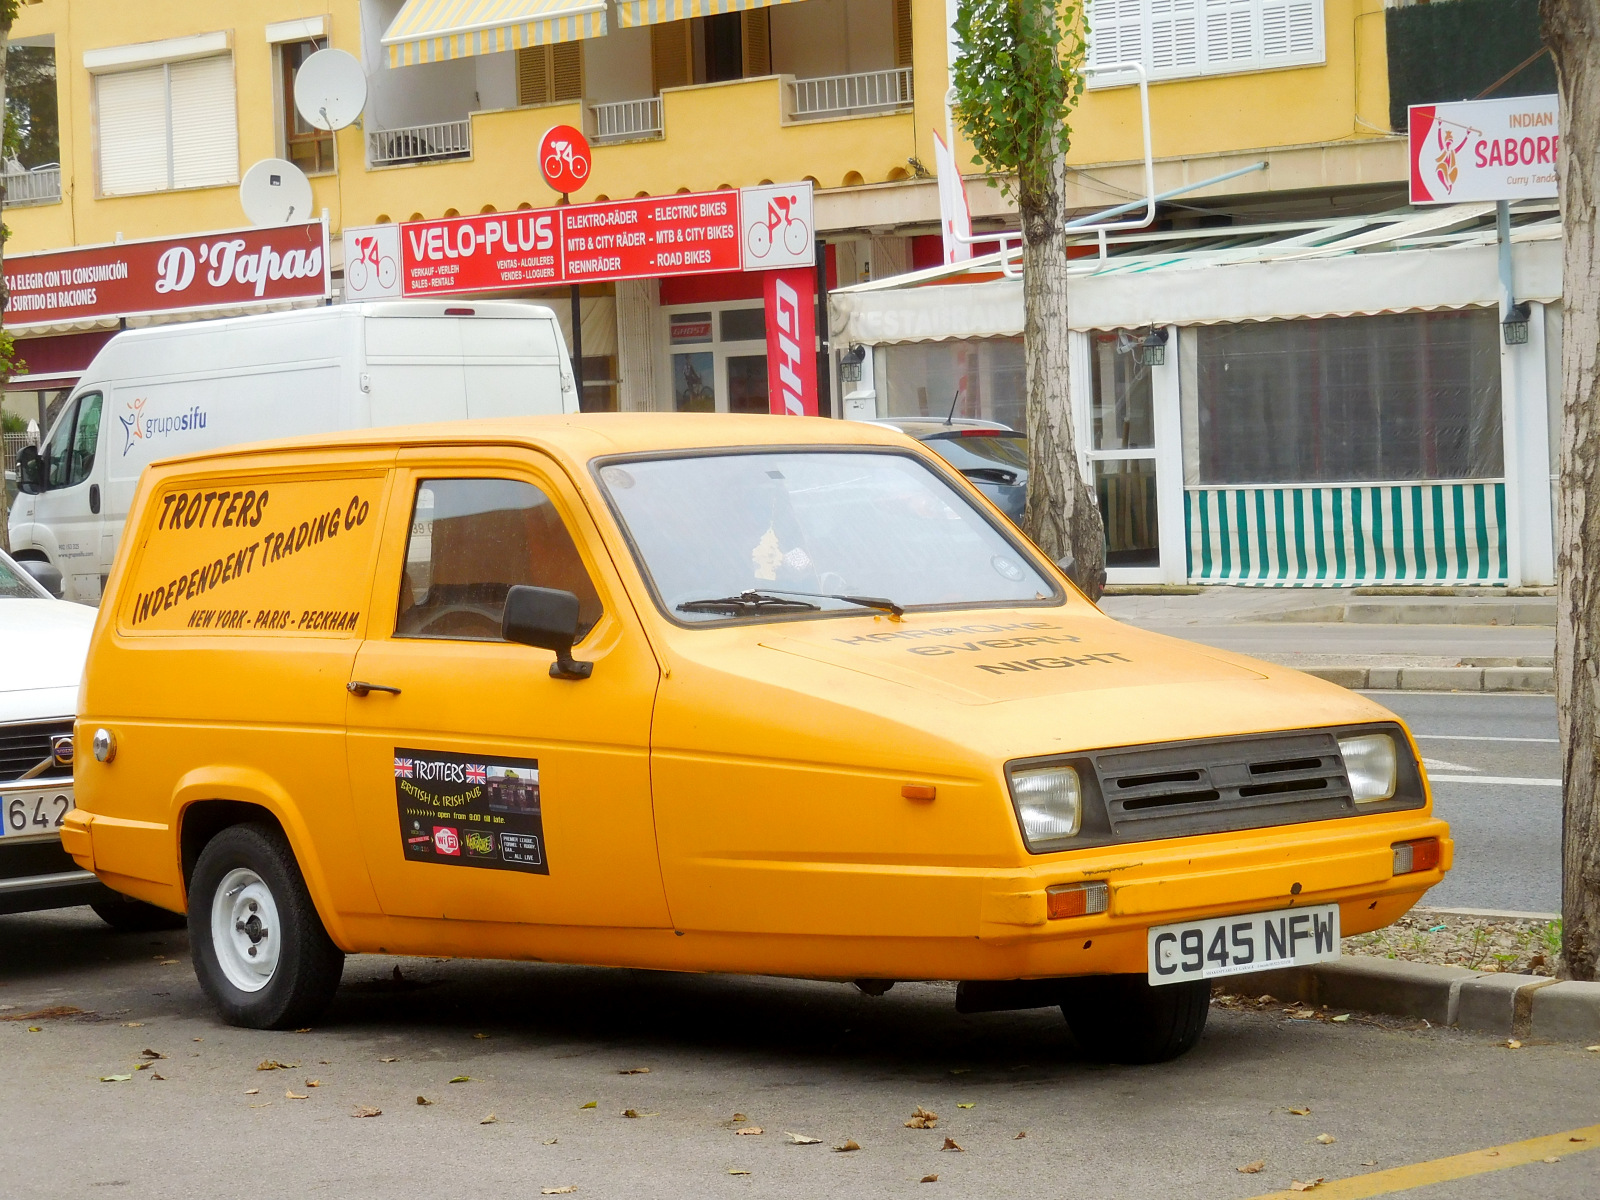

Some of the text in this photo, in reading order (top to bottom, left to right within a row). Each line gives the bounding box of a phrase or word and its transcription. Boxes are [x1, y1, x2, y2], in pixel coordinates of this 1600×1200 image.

[1509, 112, 1553, 128] INDIAN
[1506, 176, 1528, 187] Curry
[566, 210, 638, 230] ELEKTRO-RÄDER
[655, 204, 698, 222] ELECTRIC
[700, 202, 727, 216] BIKES
[408, 216, 554, 262] VELO-PLUS
[568, 232, 646, 252] MTB & CITY RÄDER
[656, 230, 676, 244] MTB
[677, 230, 684, 242] &
[685, 227, 706, 242] CITY
[706, 224, 734, 240] BIKES
[496, 258, 518, 270] VENTAS
[520, 256, 554, 268] ALQUILERES
[568, 256, 622, 274] RENNRÄDER
[657, 252, 683, 267] ROAD
[684, 250, 711, 264] BIKES
[10, 275, 16, 290] A
[17, 272, 44, 290] ELEGIR
[44, 270, 60, 288] CON
[60, 270, 72, 286] TU
[72, 260, 128, 284] CONSUMICIÓN
[410, 266, 434, 278] VERKAUF
[438, 264, 460, 275] VERLEIH
[500, 270, 522, 281] VENDES
[526, 268, 554, 280] LLOGUERS
[412, 279, 428, 290] SALES
[432, 277, 454, 288] RENTALS
[12, 293, 46, 312] SURTIDO
[46, 292, 58, 308] EN
[58, 288, 97, 308] RACIONES
[146, 406, 206, 438] gruposifu
[158, 490, 270, 531] TROTTERS
[132, 542, 260, 626] INDEPENDENT
[262, 508, 341, 568] TRADING
[188, 610, 211, 628] NEW
[214, 610, 247, 629] YORK
[254, 610, 290, 629] PARIS
[298, 610, 360, 630] PECKHAM
[833, 622, 1064, 646] KARAOKE
[906, 634, 1081, 656] EVERY
[974, 652, 1134, 675] NIGHT
[414, 760, 464, 784] TROTTERS
[400, 780, 482, 806] BRITISH & IRISH PUB
[10, 795, 76, 830] 642
[454, 812, 466, 820] from
[1155, 912, 1333, 976] C945 NFW
